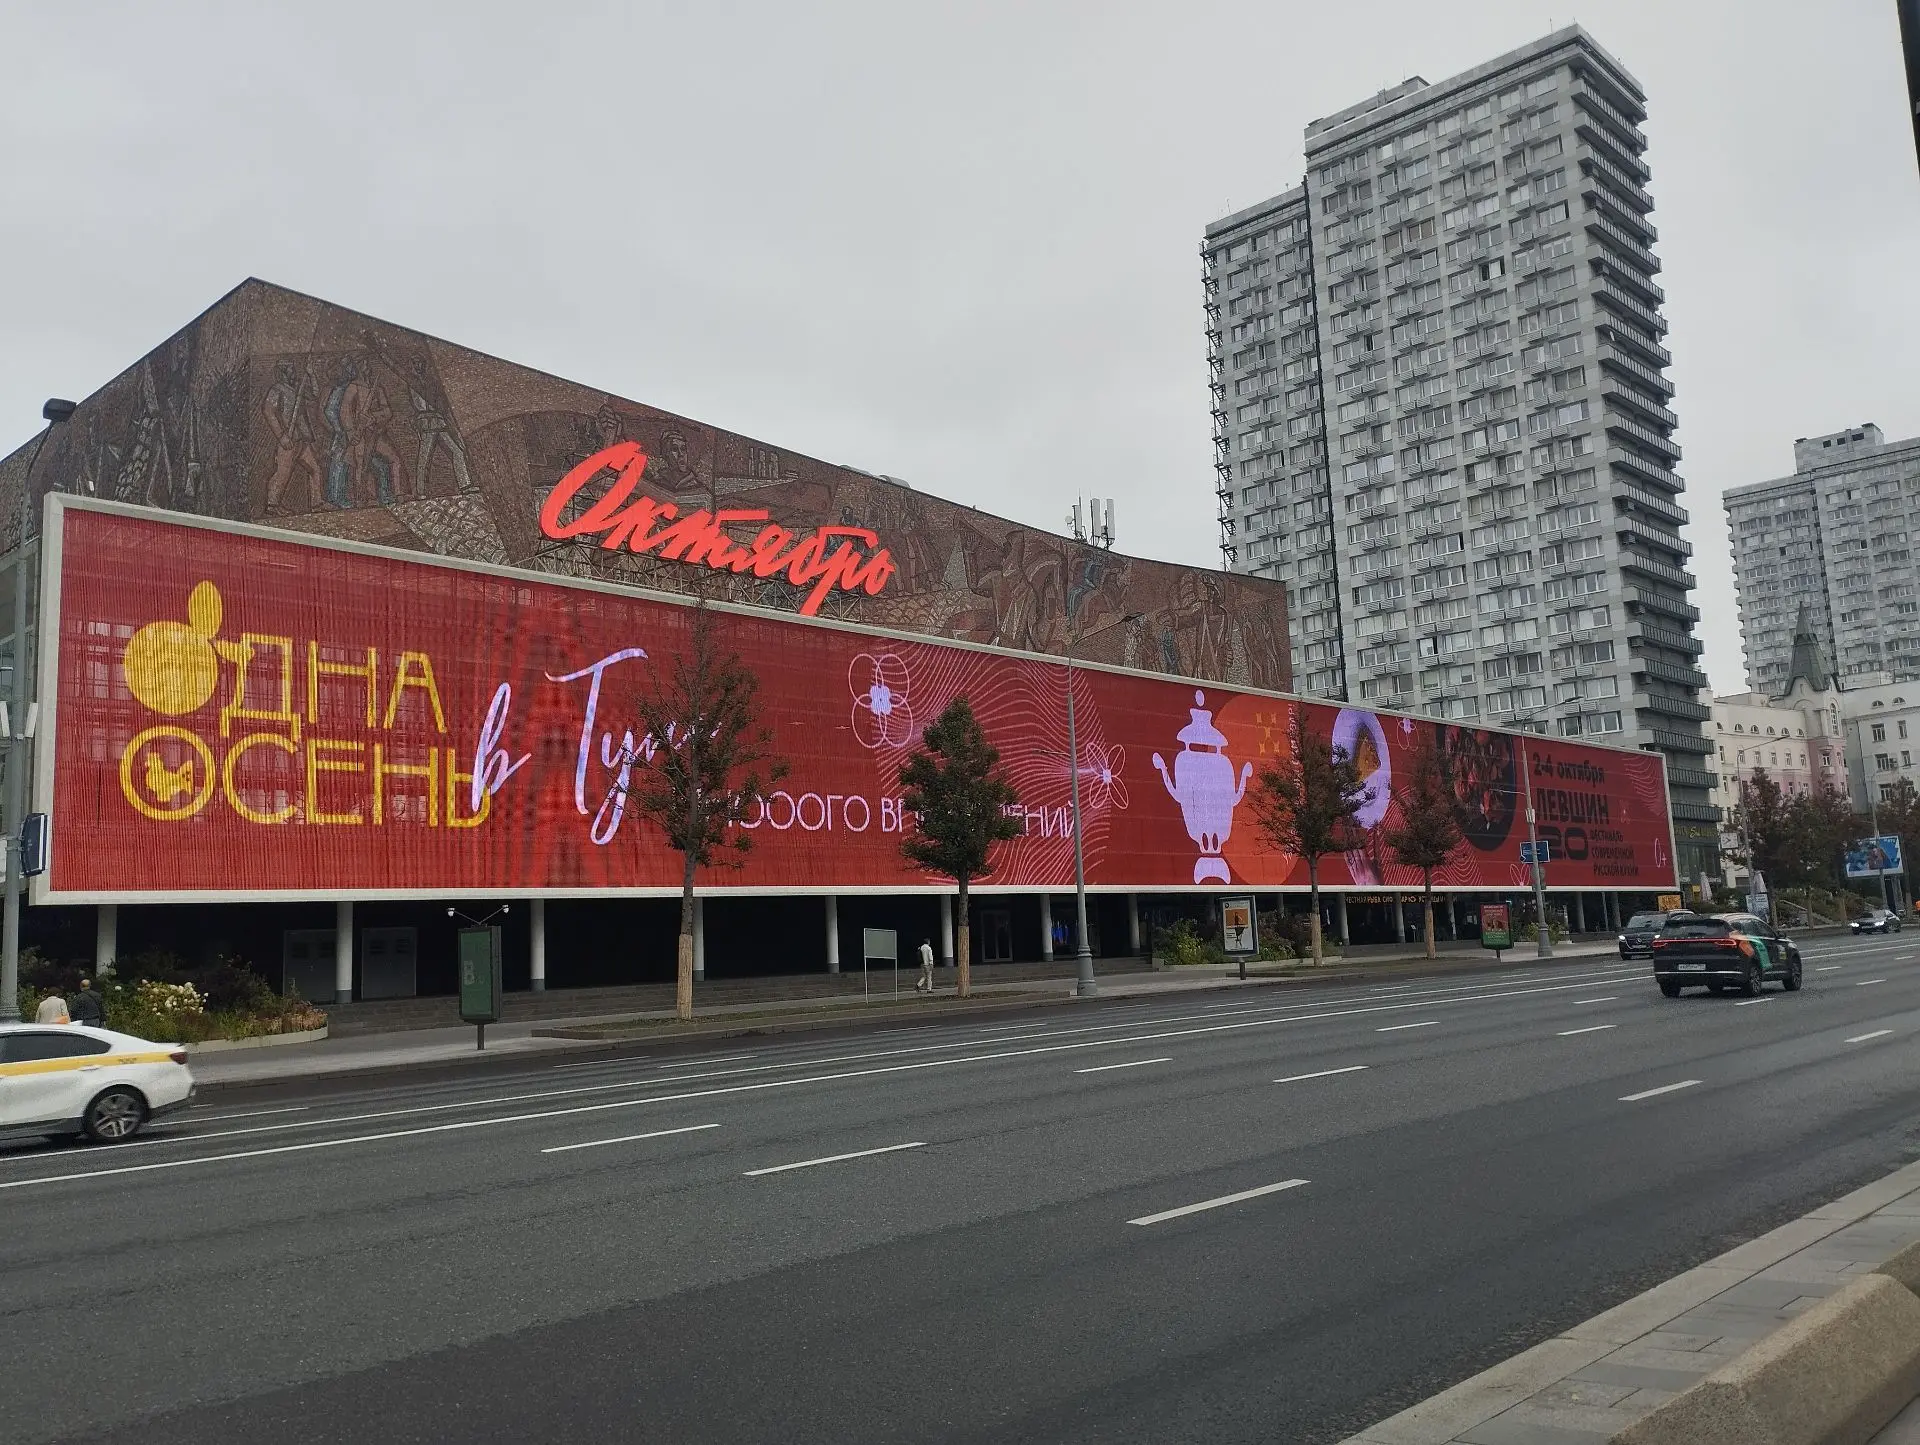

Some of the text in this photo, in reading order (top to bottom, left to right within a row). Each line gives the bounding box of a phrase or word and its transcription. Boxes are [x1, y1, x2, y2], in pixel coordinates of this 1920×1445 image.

[540, 440, 896, 616] Октябрь
[119, 726, 491, 829] ОСЕНЬ
[1536, 788, 1610, 824] ЛЕВШИН
[1557, 760, 1605, 788] октября
